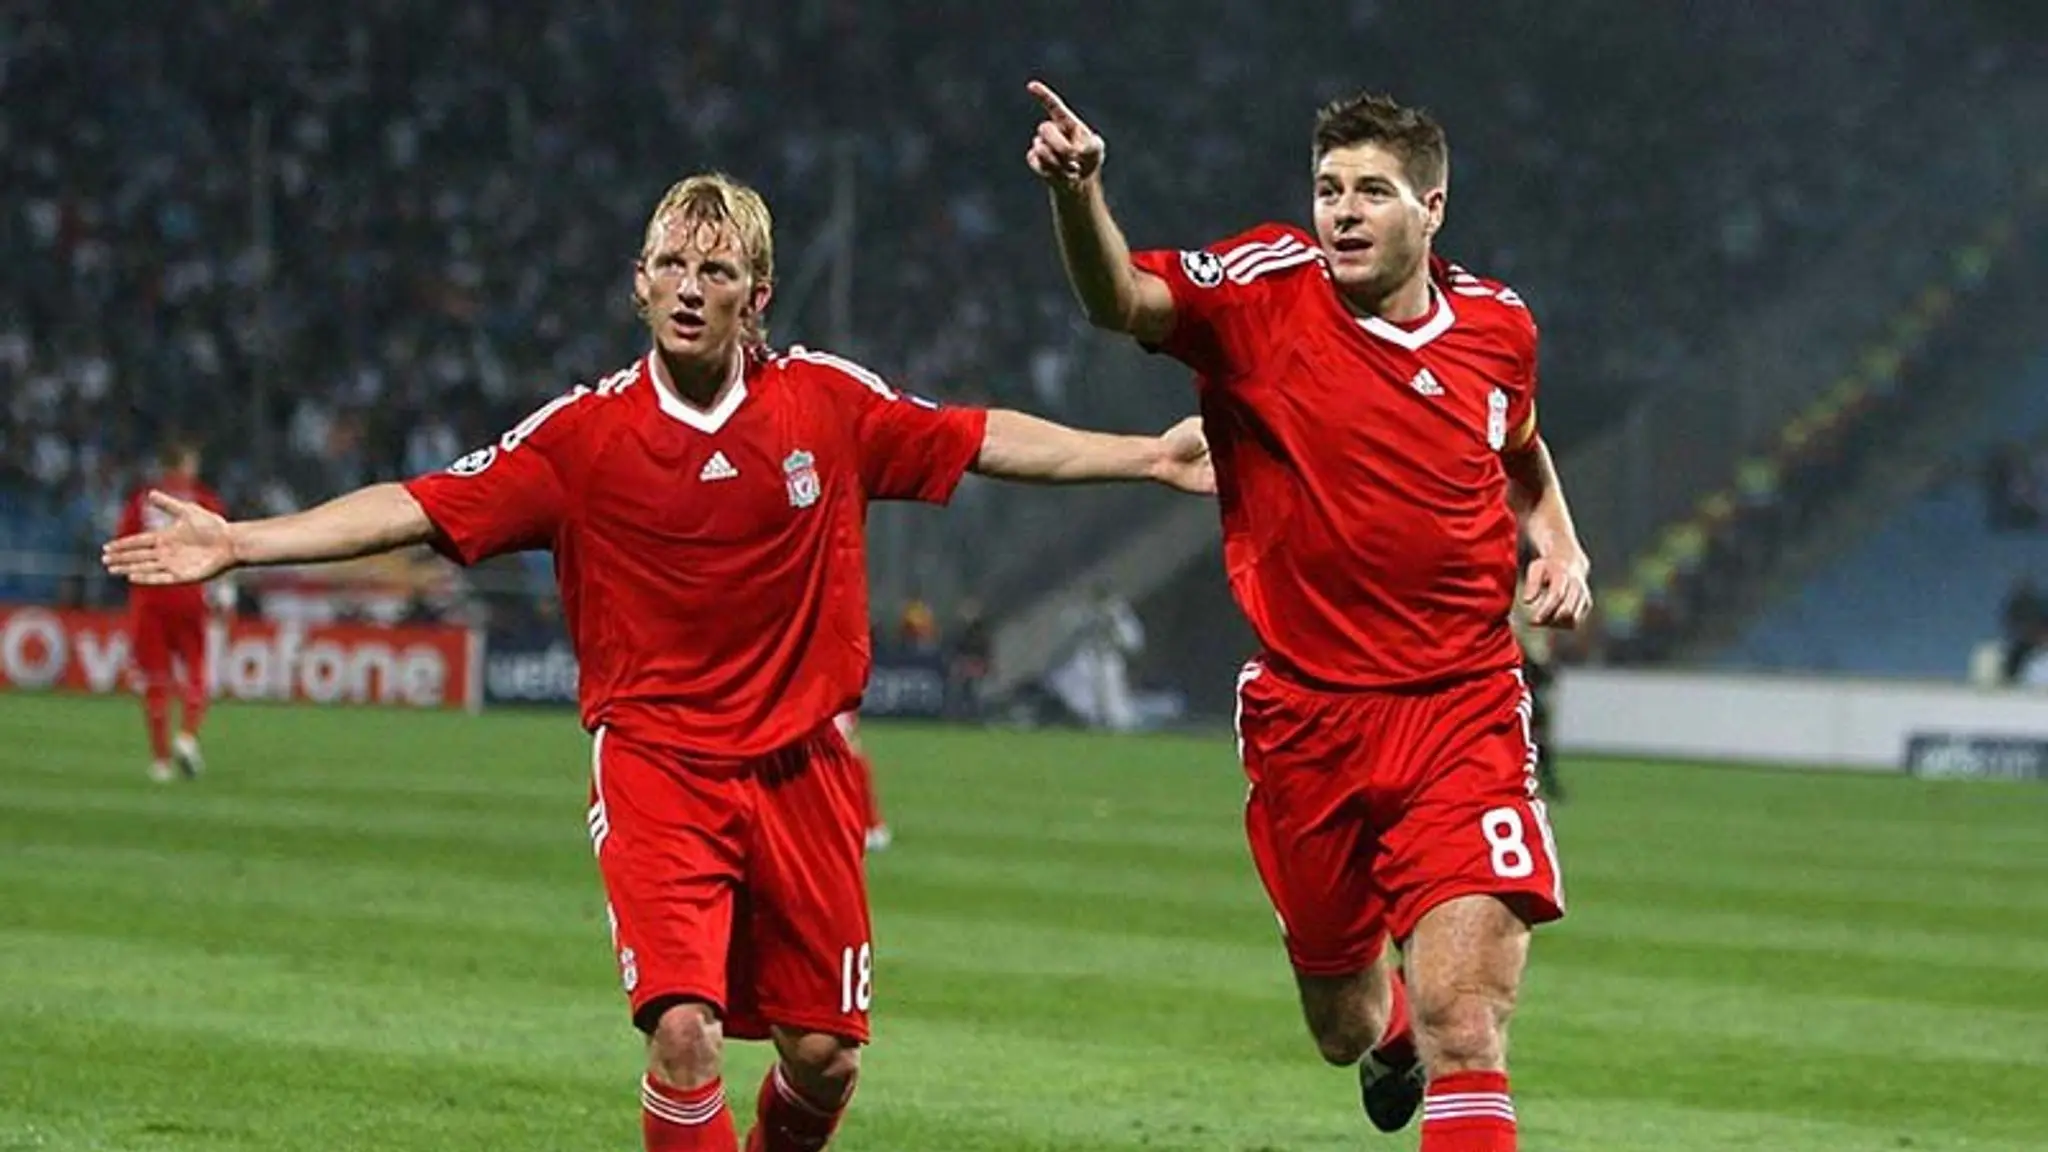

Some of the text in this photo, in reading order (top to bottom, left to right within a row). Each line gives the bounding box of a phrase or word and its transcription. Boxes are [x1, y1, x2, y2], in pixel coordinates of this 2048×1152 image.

[76, 616, 444, 706] vafone
[1481, 806, 1533, 878] 8
[842, 942, 871, 1013] 18
